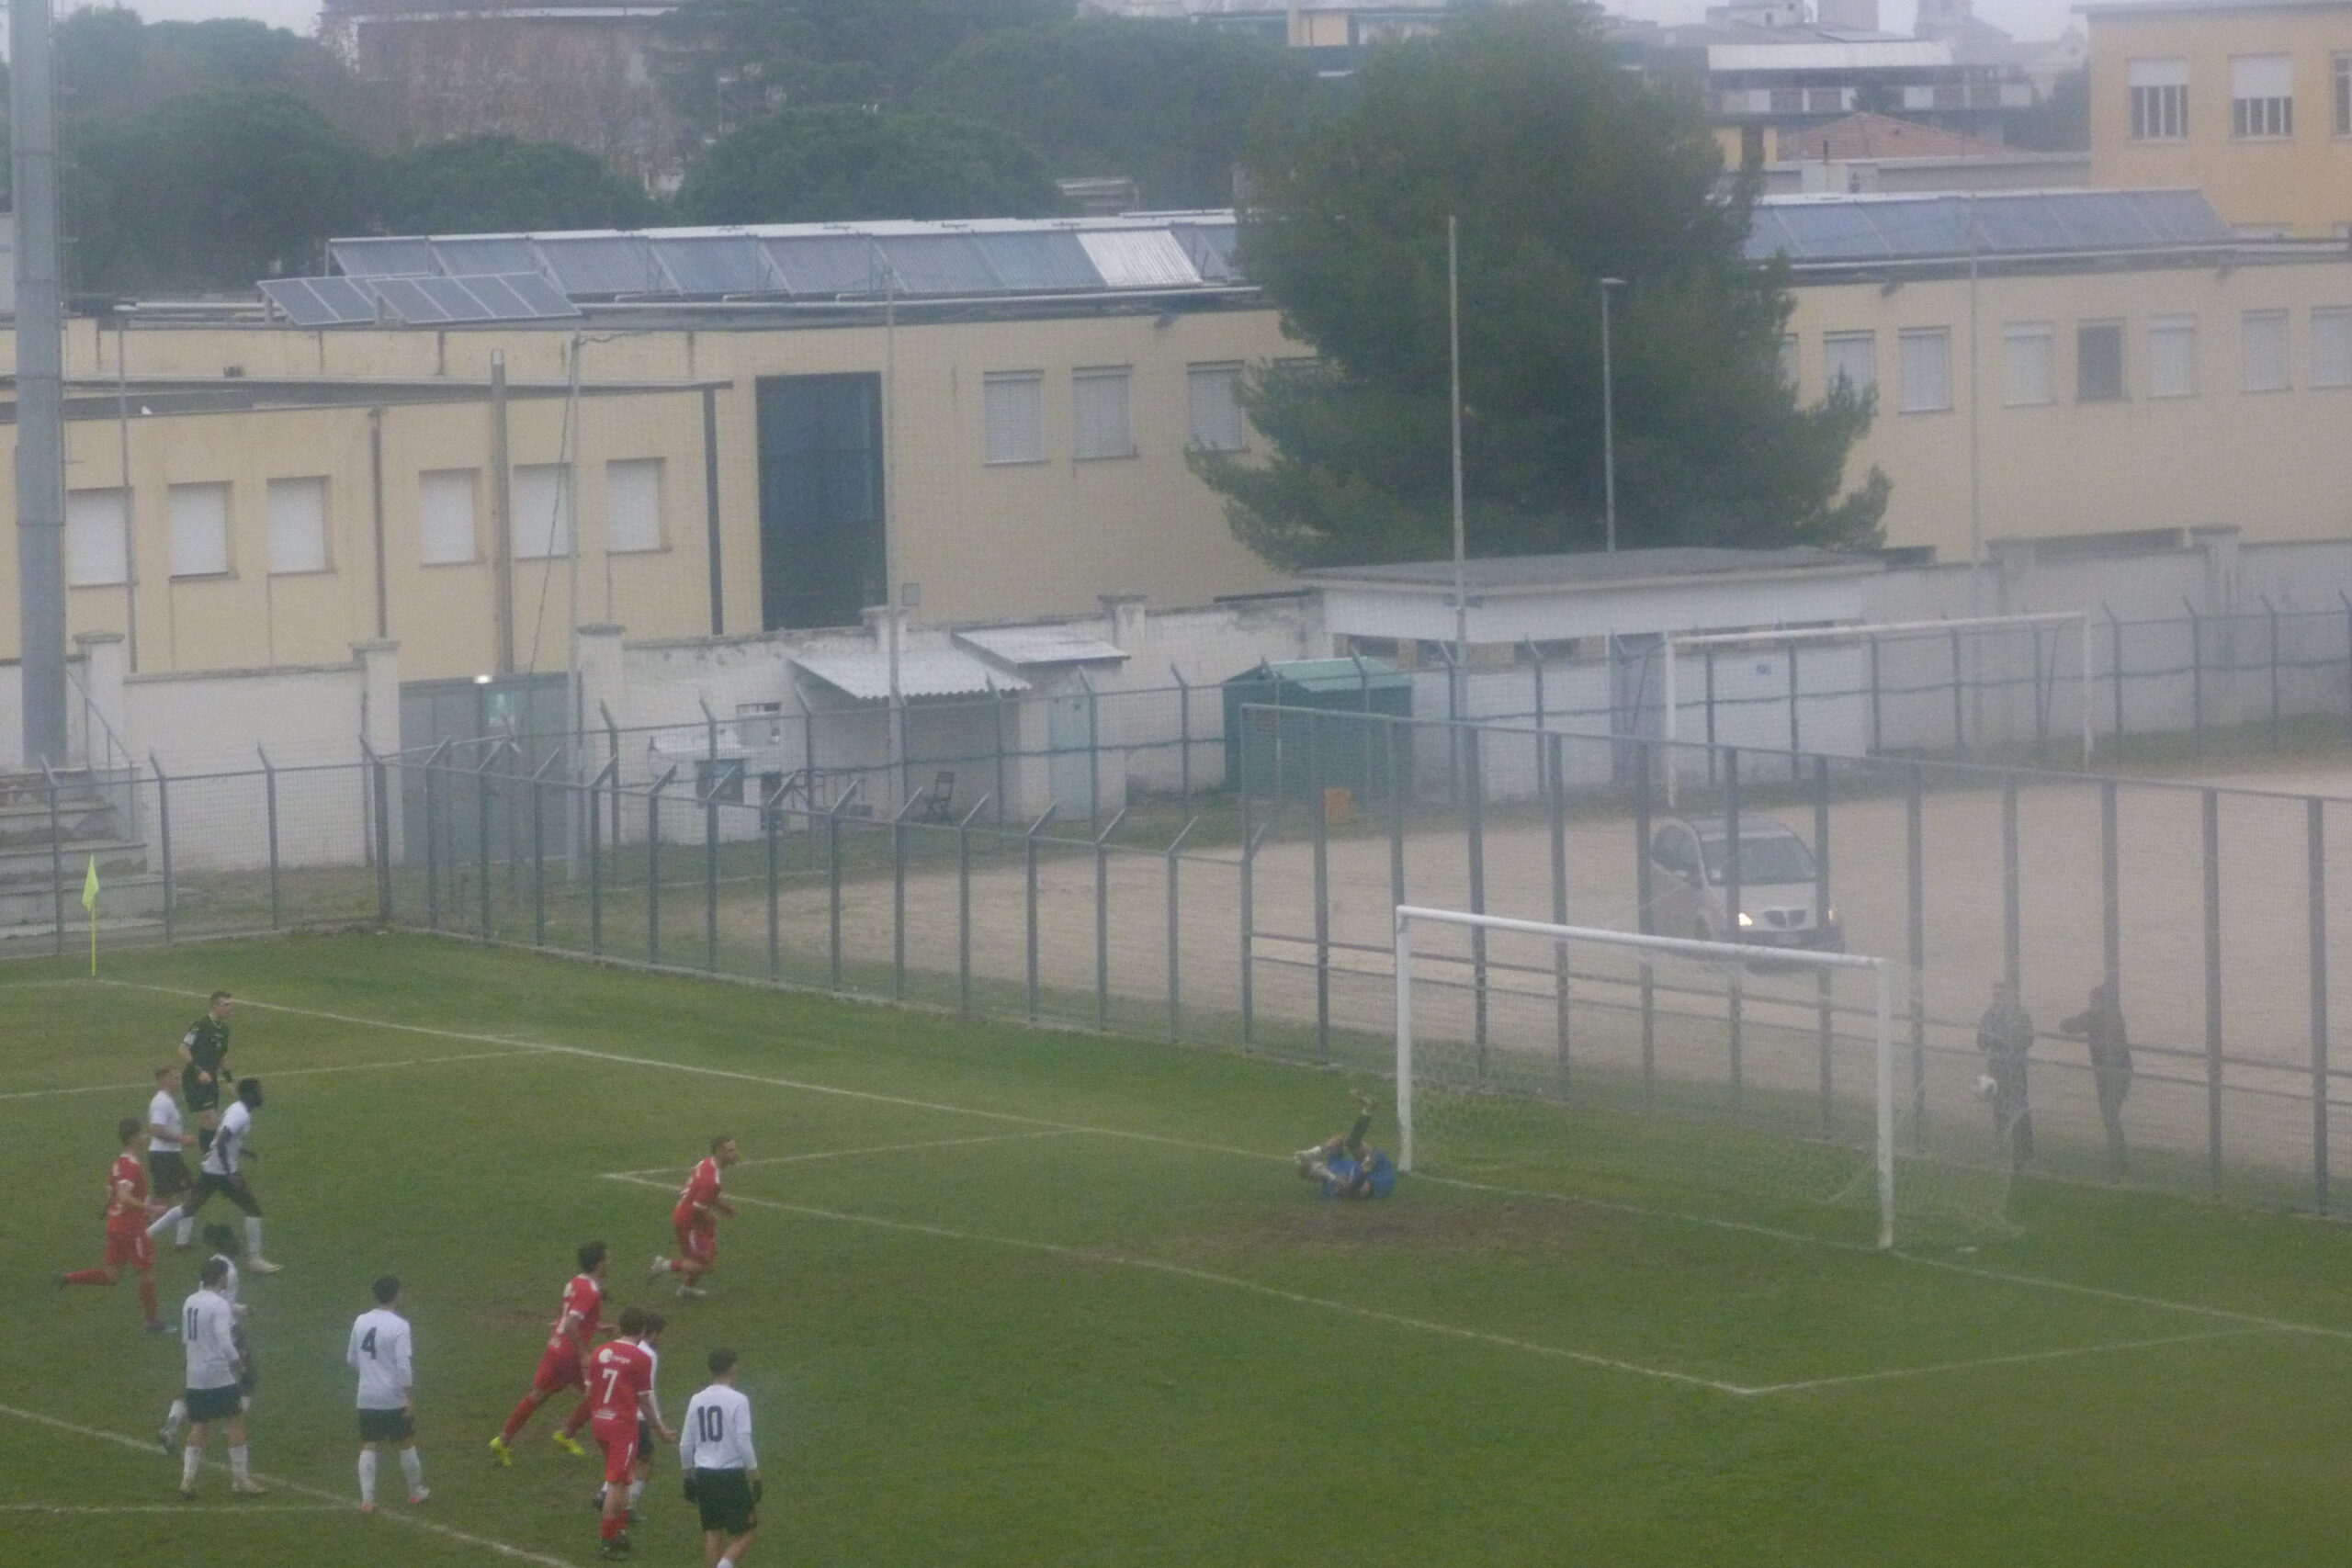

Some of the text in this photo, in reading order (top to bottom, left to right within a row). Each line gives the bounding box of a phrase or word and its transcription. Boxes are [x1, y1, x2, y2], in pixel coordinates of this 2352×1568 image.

[187, 1307, 199, 1341] 11
[360, 1326, 377, 1359] 4
[602, 1368, 618, 1404] 7
[697, 1405, 723, 1442] 10
